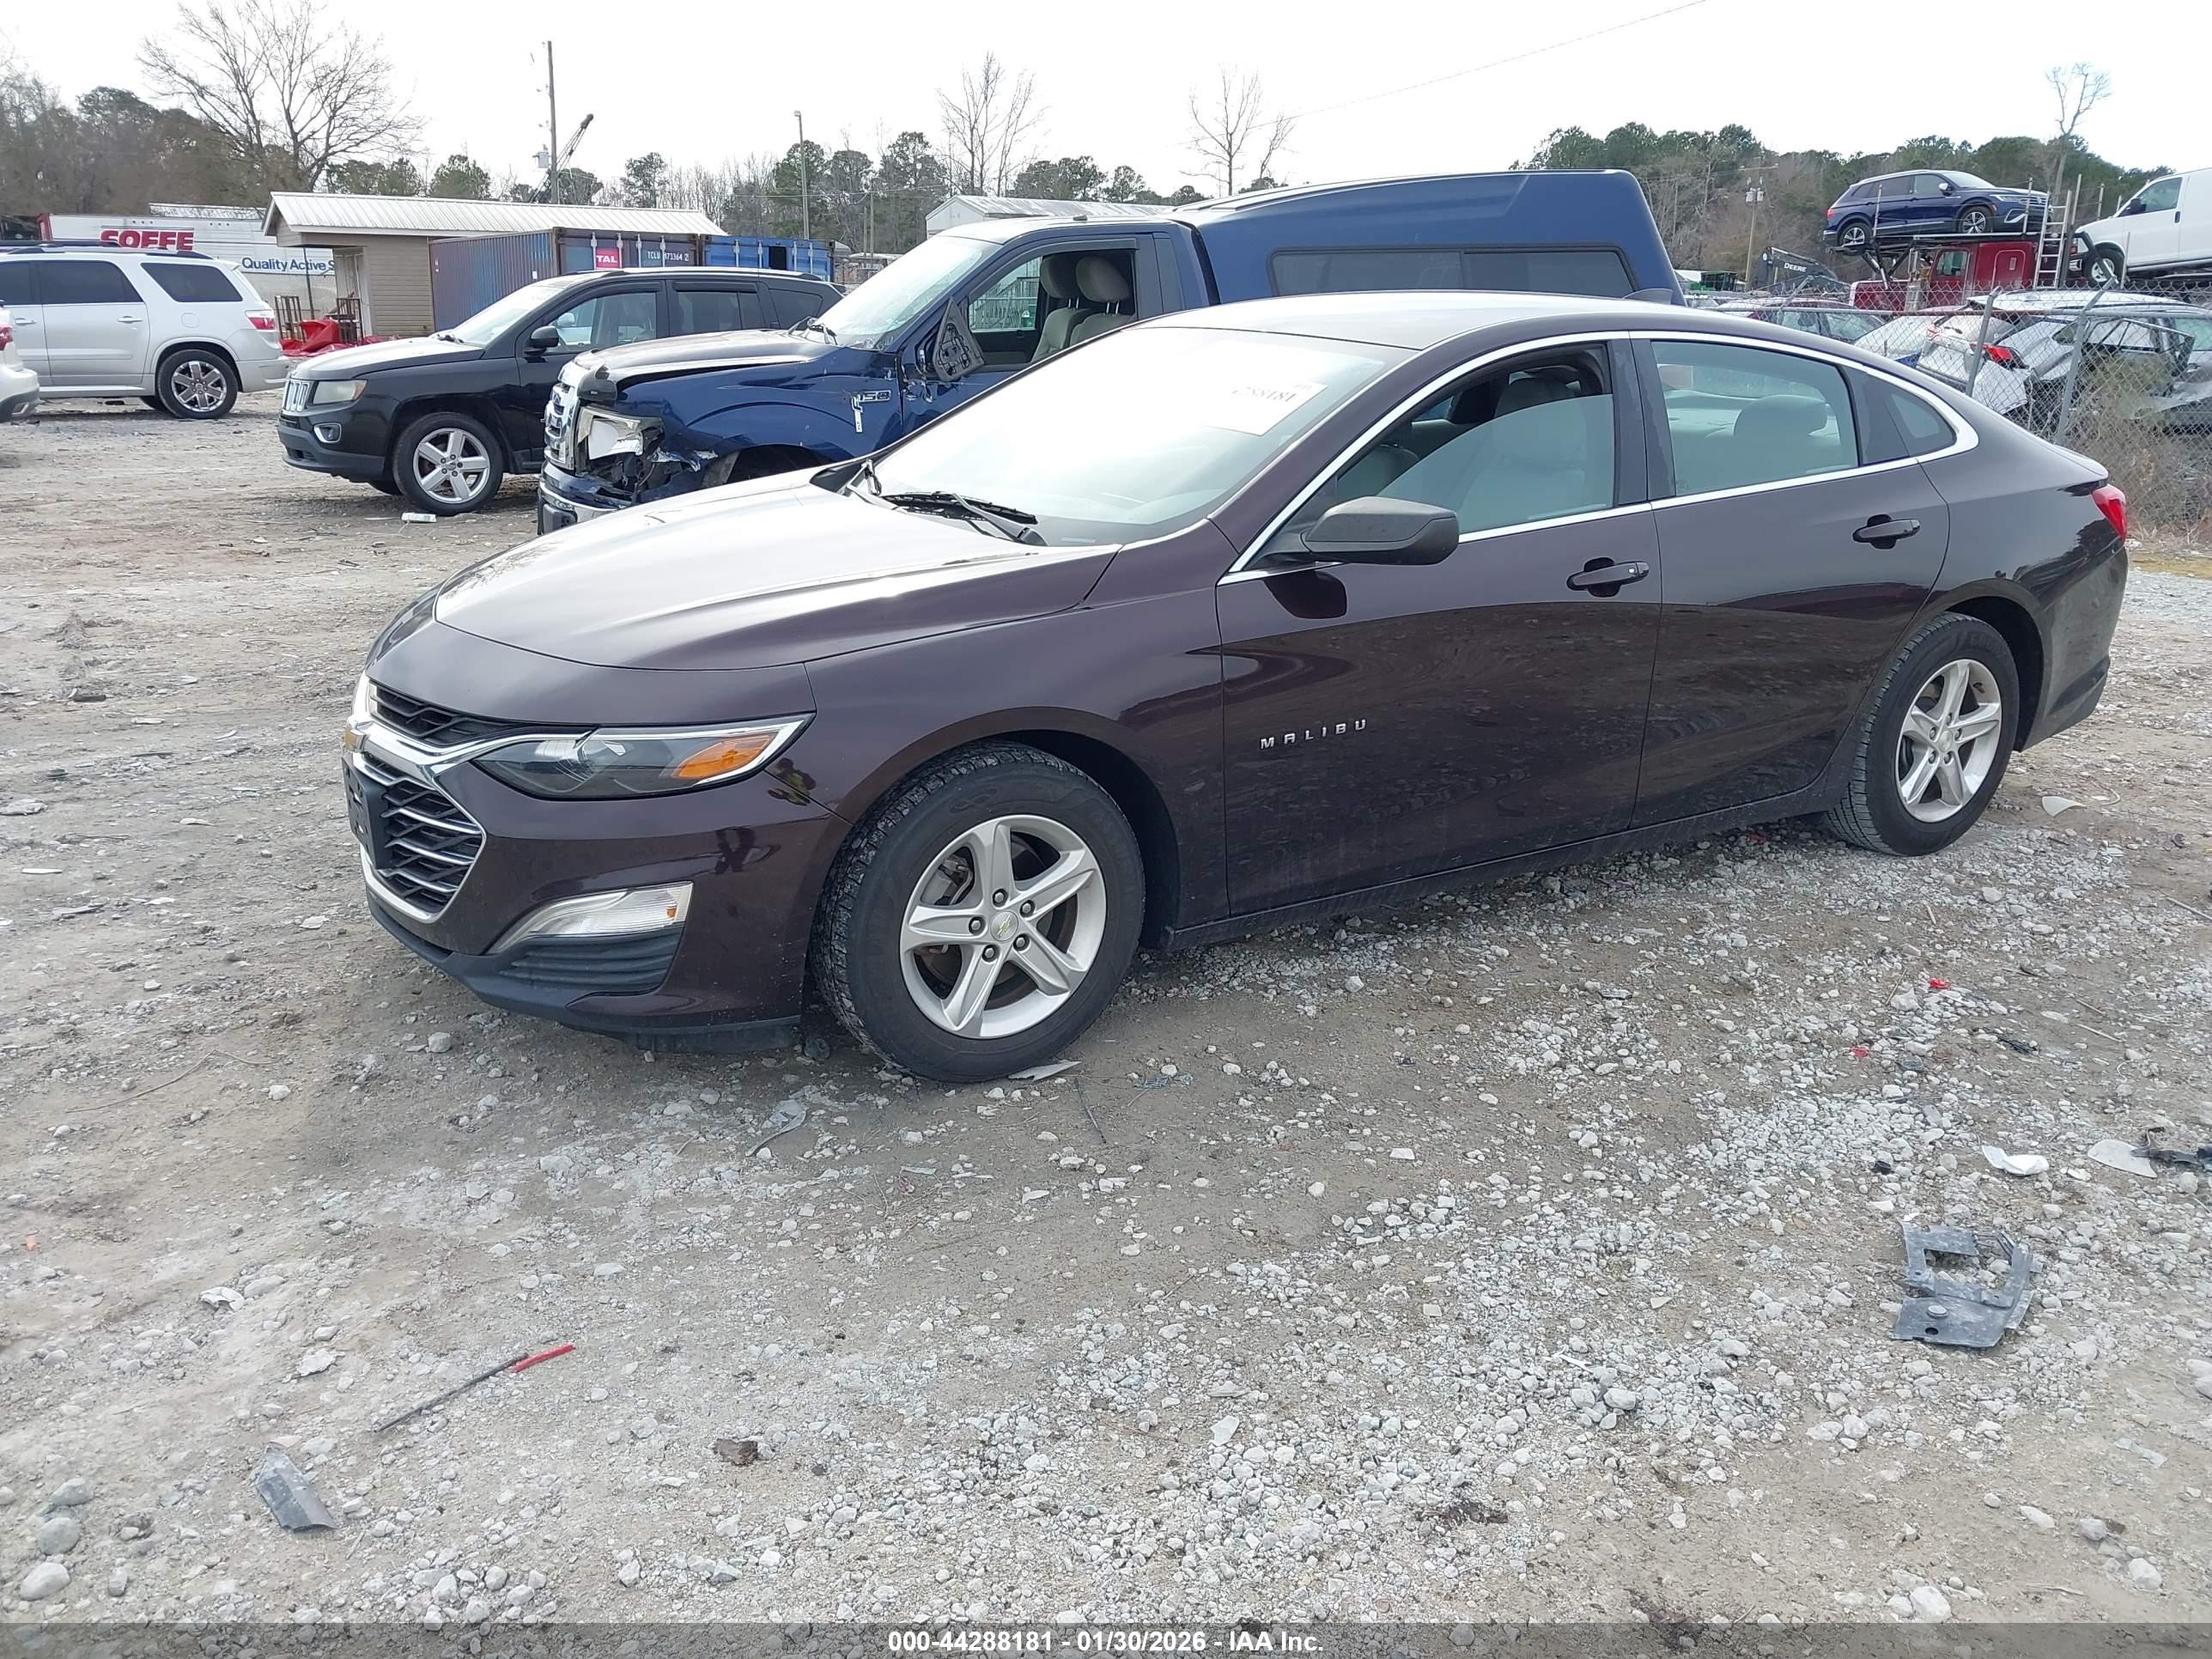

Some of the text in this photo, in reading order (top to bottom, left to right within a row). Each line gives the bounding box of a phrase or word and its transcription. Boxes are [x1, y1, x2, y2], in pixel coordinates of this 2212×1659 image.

[647, 251, 660, 259] TCLU
[241, 257, 288, 272] Quality
[289, 258, 327, 271] Active
[1784, 262, 1808, 272] DEERE
[1260, 719, 1366, 750] MALIBU
